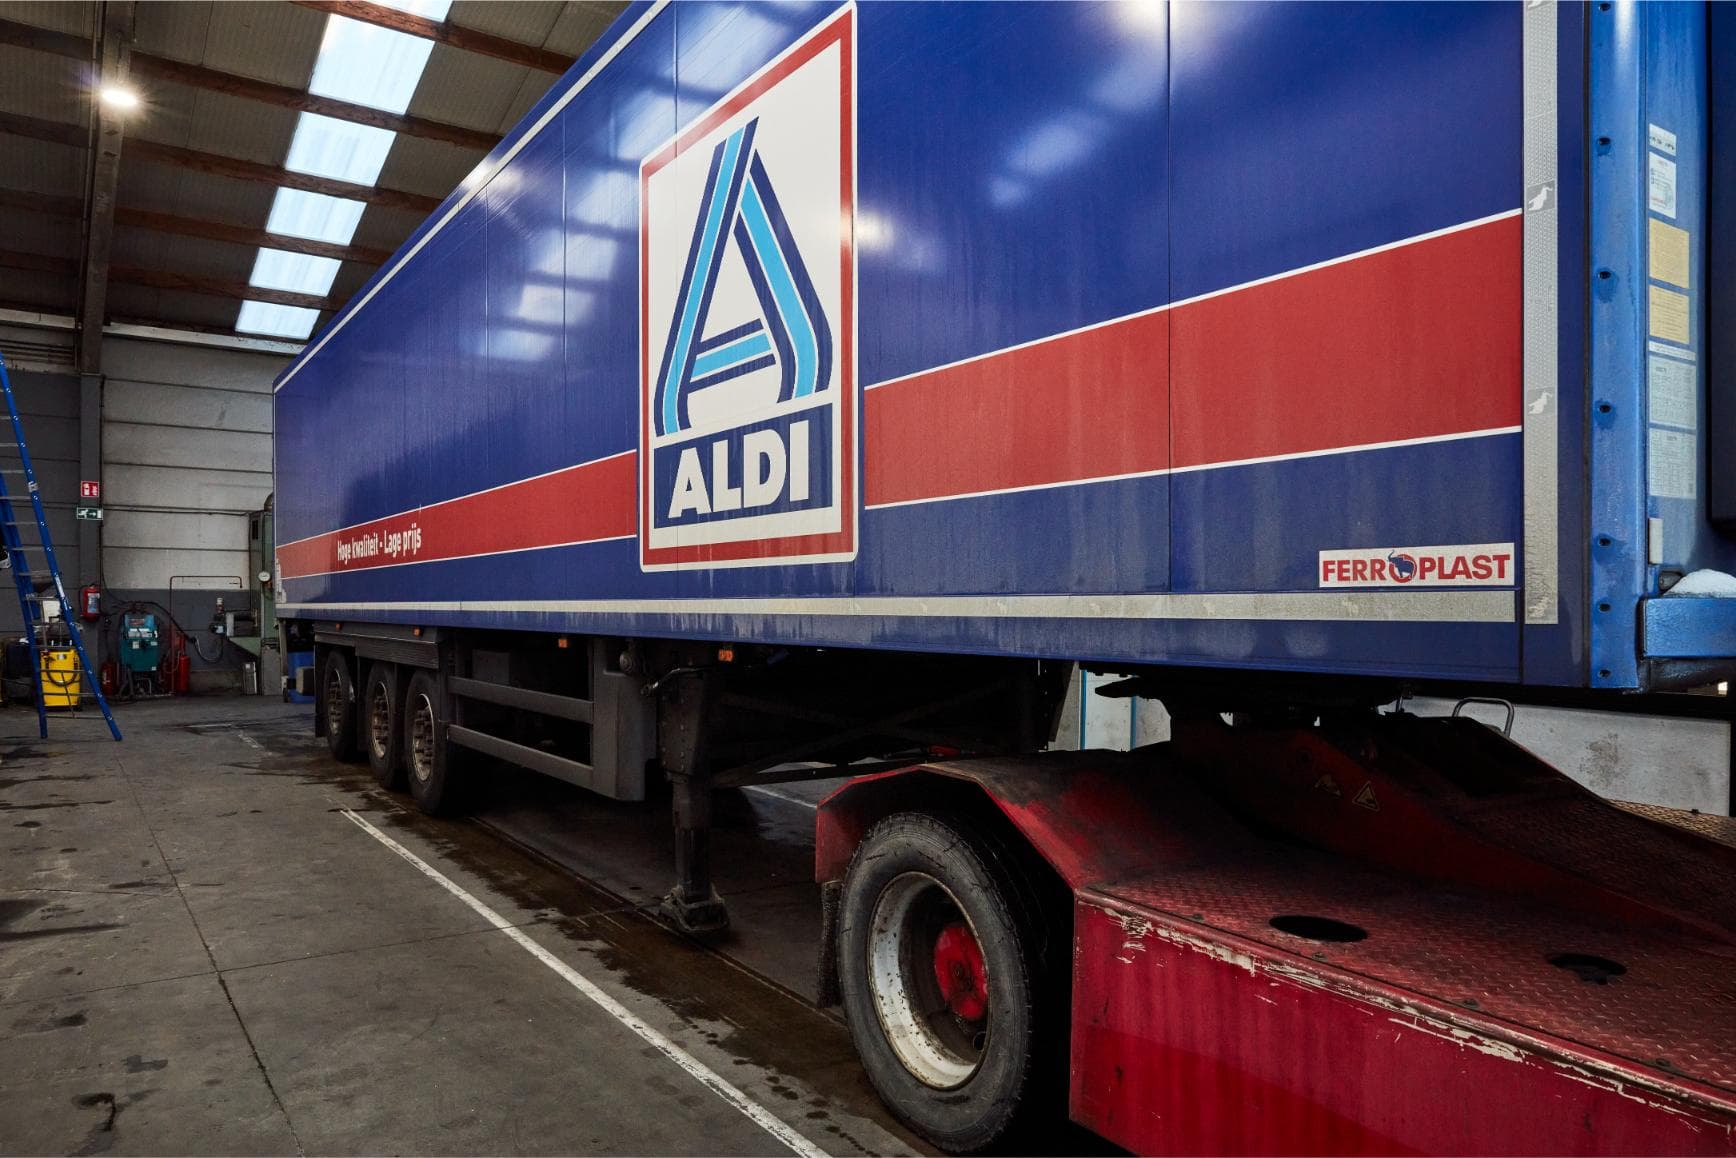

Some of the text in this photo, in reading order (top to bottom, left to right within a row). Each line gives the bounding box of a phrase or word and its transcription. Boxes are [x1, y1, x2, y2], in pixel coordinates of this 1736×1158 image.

[668, 420, 808, 519] ALDI
[337, 540, 351, 565] Hoge
[352, 532, 379, 558] kwaliteit
[384, 530, 401, 558] Lage
[402, 523, 422, 556] prijs
[1322, 553, 1511, 583] FERROPLAST
